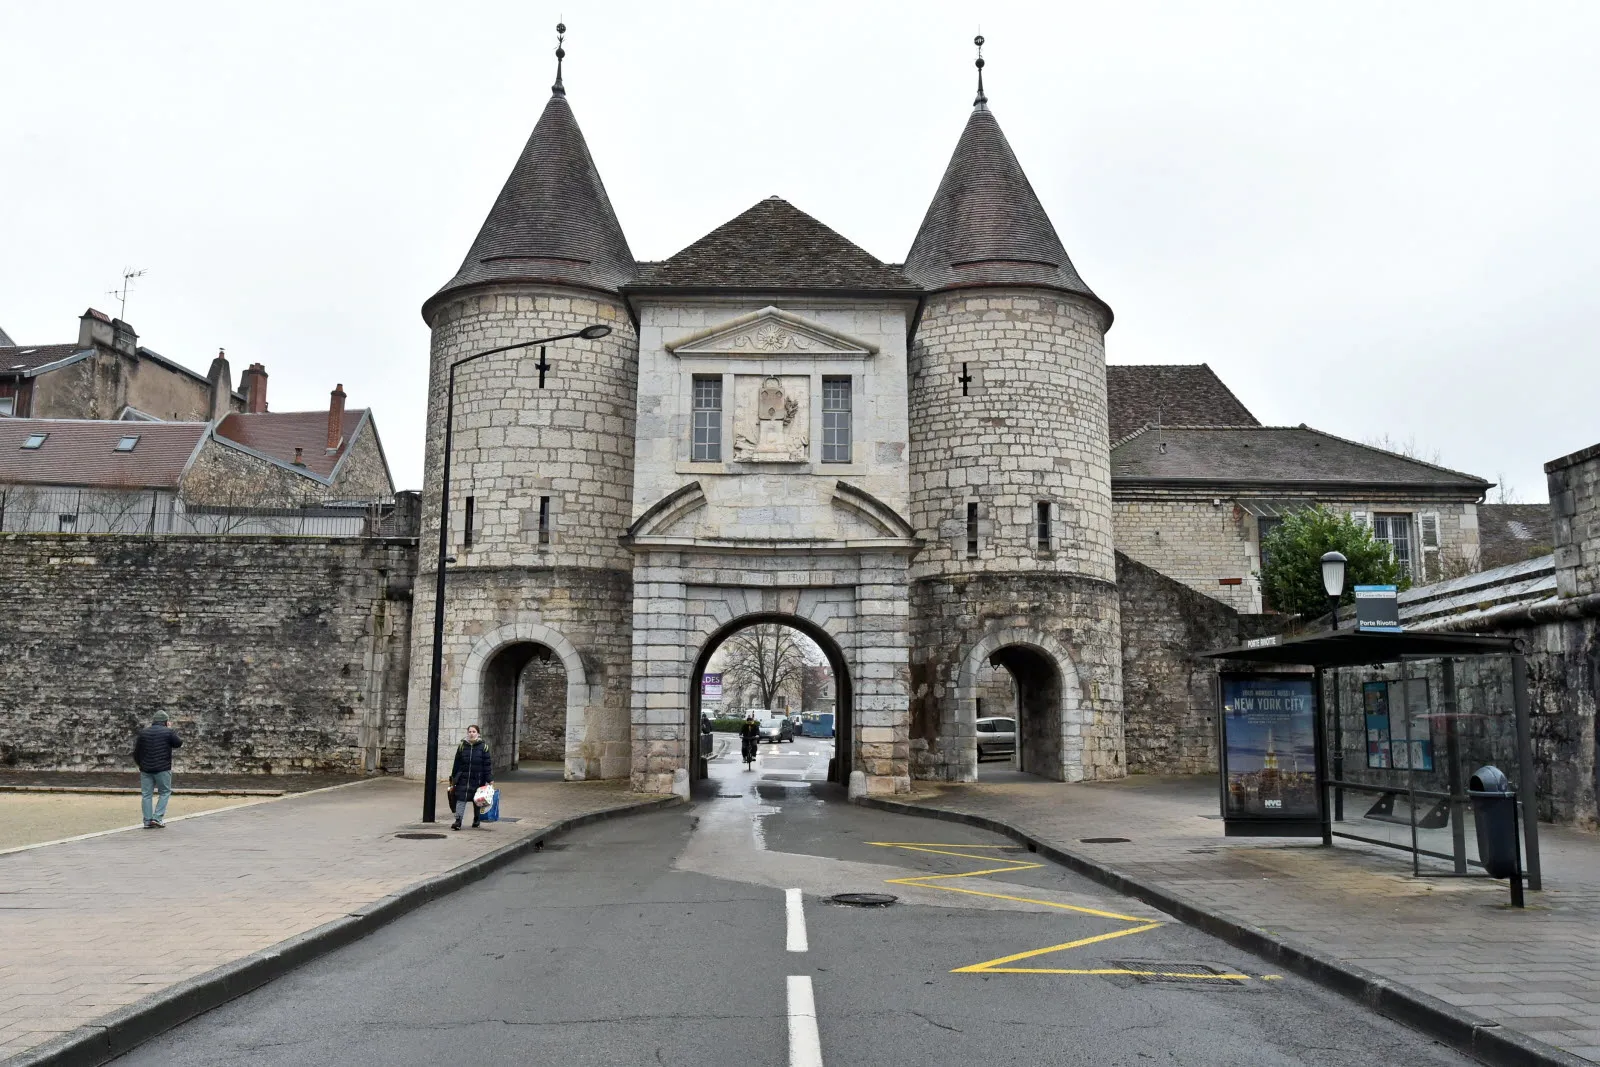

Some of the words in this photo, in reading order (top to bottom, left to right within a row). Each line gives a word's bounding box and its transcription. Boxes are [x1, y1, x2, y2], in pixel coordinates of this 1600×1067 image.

[1247, 639, 1260, 648] PORTE
[1234, 697, 1254, 710] NEW
[1257, 698, 1281, 710] YORK
[1284, 698, 1305, 711] CITY
